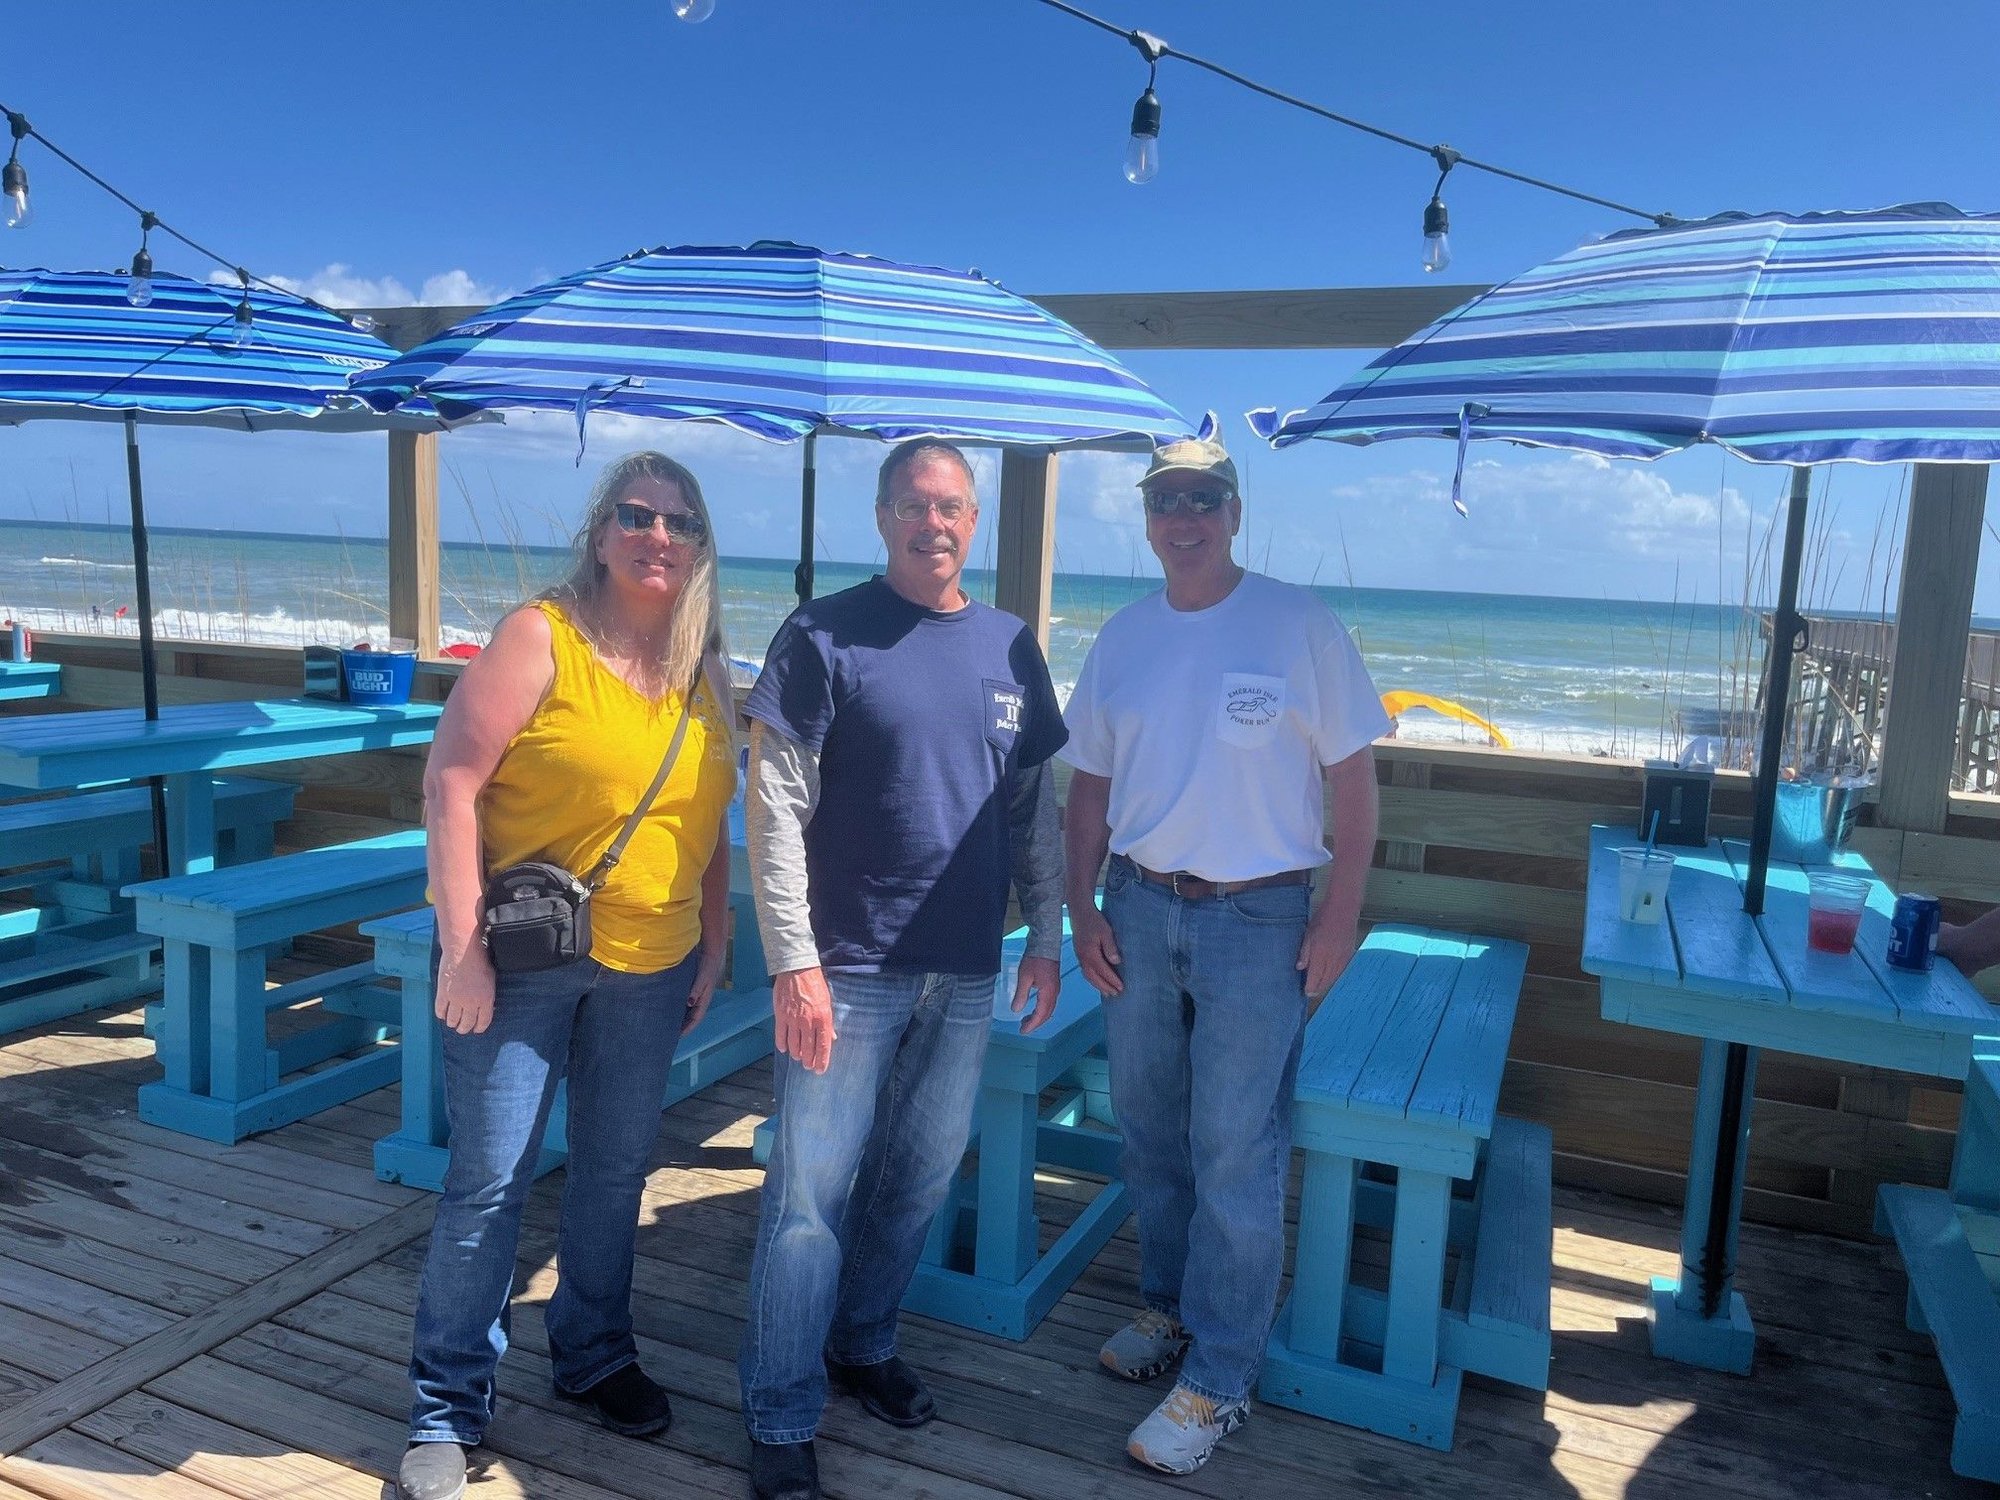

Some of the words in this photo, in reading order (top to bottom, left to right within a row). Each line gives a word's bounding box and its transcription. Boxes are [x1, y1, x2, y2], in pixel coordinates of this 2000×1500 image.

[354, 671, 384, 682] BUD
[352, 681, 390, 692] LIGHT
[1227, 687, 1262, 699] EMERALD
[1263, 690, 1279, 704] ISLE
[1230, 714, 1254, 726] POKER
[1256, 717, 1270, 726] RUN
